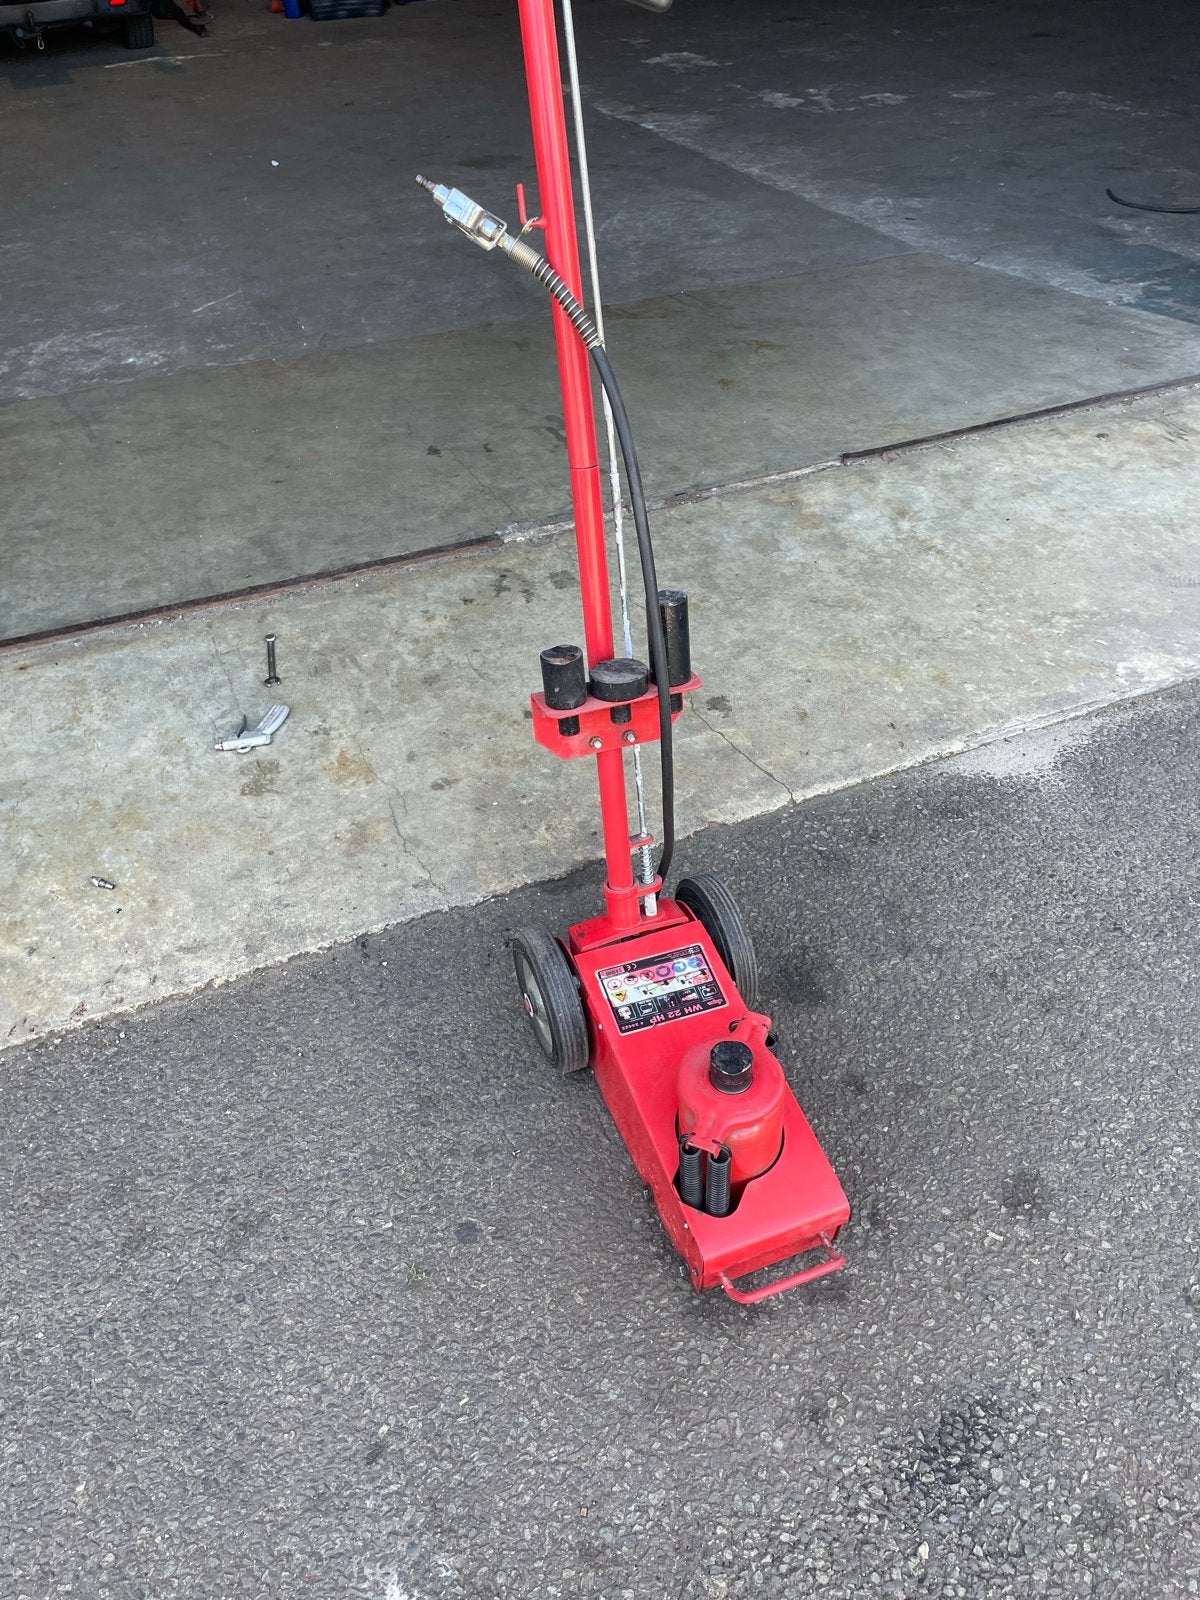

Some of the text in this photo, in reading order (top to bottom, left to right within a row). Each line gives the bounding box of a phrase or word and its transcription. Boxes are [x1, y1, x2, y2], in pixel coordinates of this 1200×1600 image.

[626, 963, 638, 971] CE
[684, 1003, 703, 1014] WH
[649, 1013, 666, 1024] HP
[666, 1009, 682, 1019] 22
